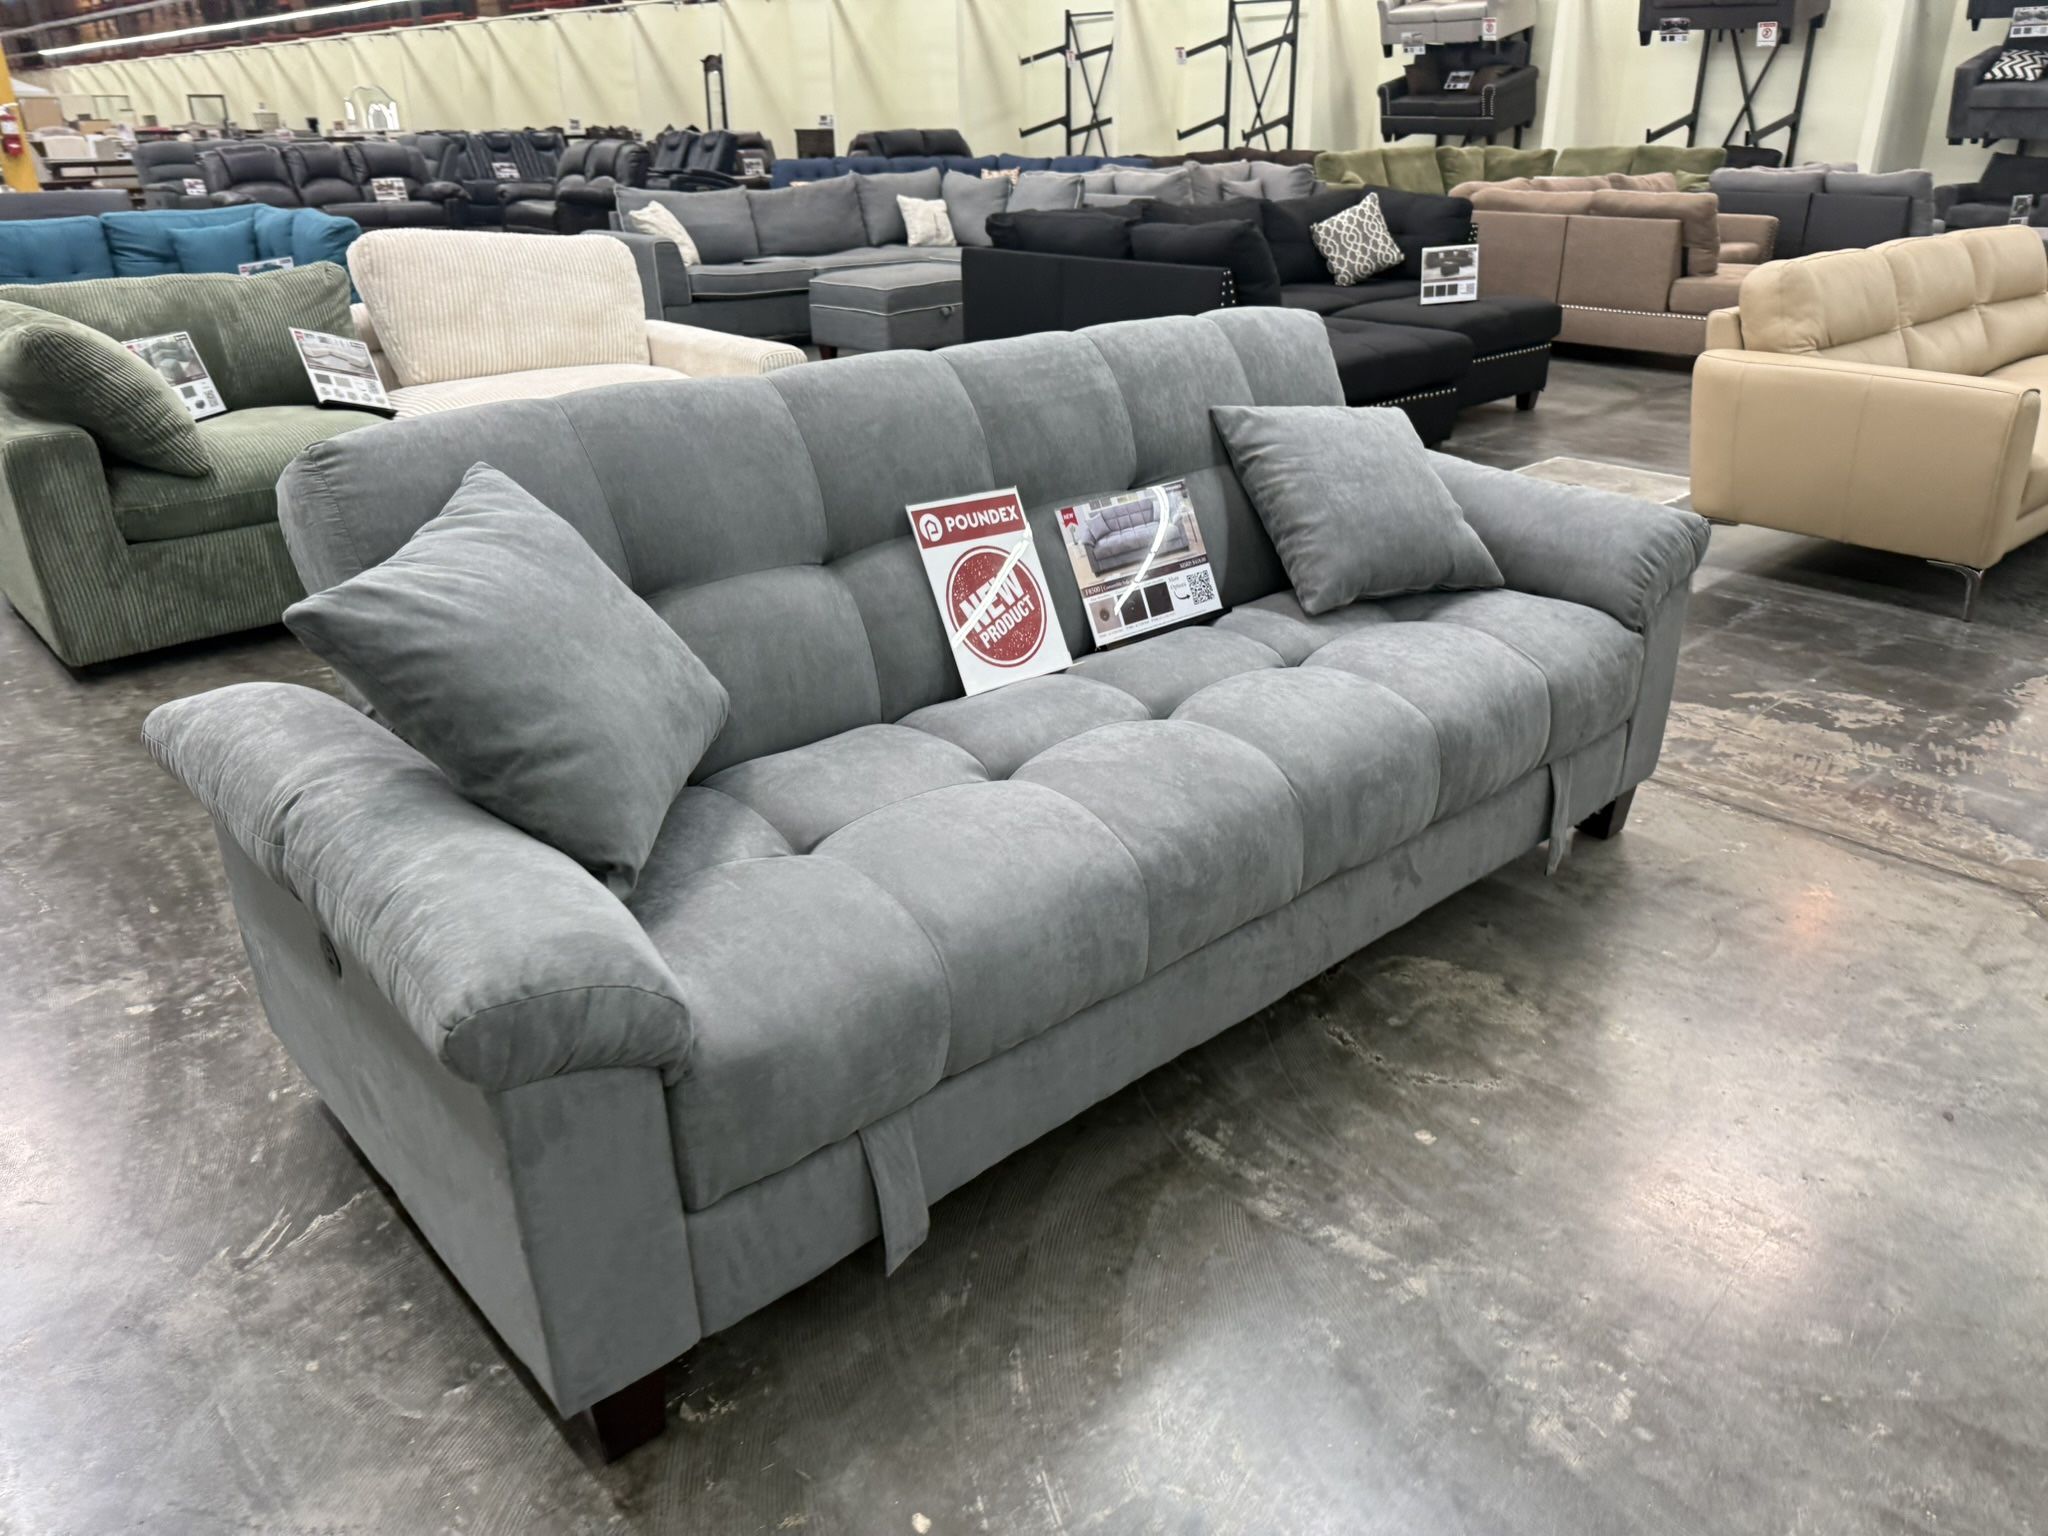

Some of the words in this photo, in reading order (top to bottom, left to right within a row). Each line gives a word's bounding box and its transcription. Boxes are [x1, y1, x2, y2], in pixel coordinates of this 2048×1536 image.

[944, 505, 1019, 533] POUNDEX
[959, 567, 1024, 634] NEW
[979, 594, 1035, 649] PRODUCT
